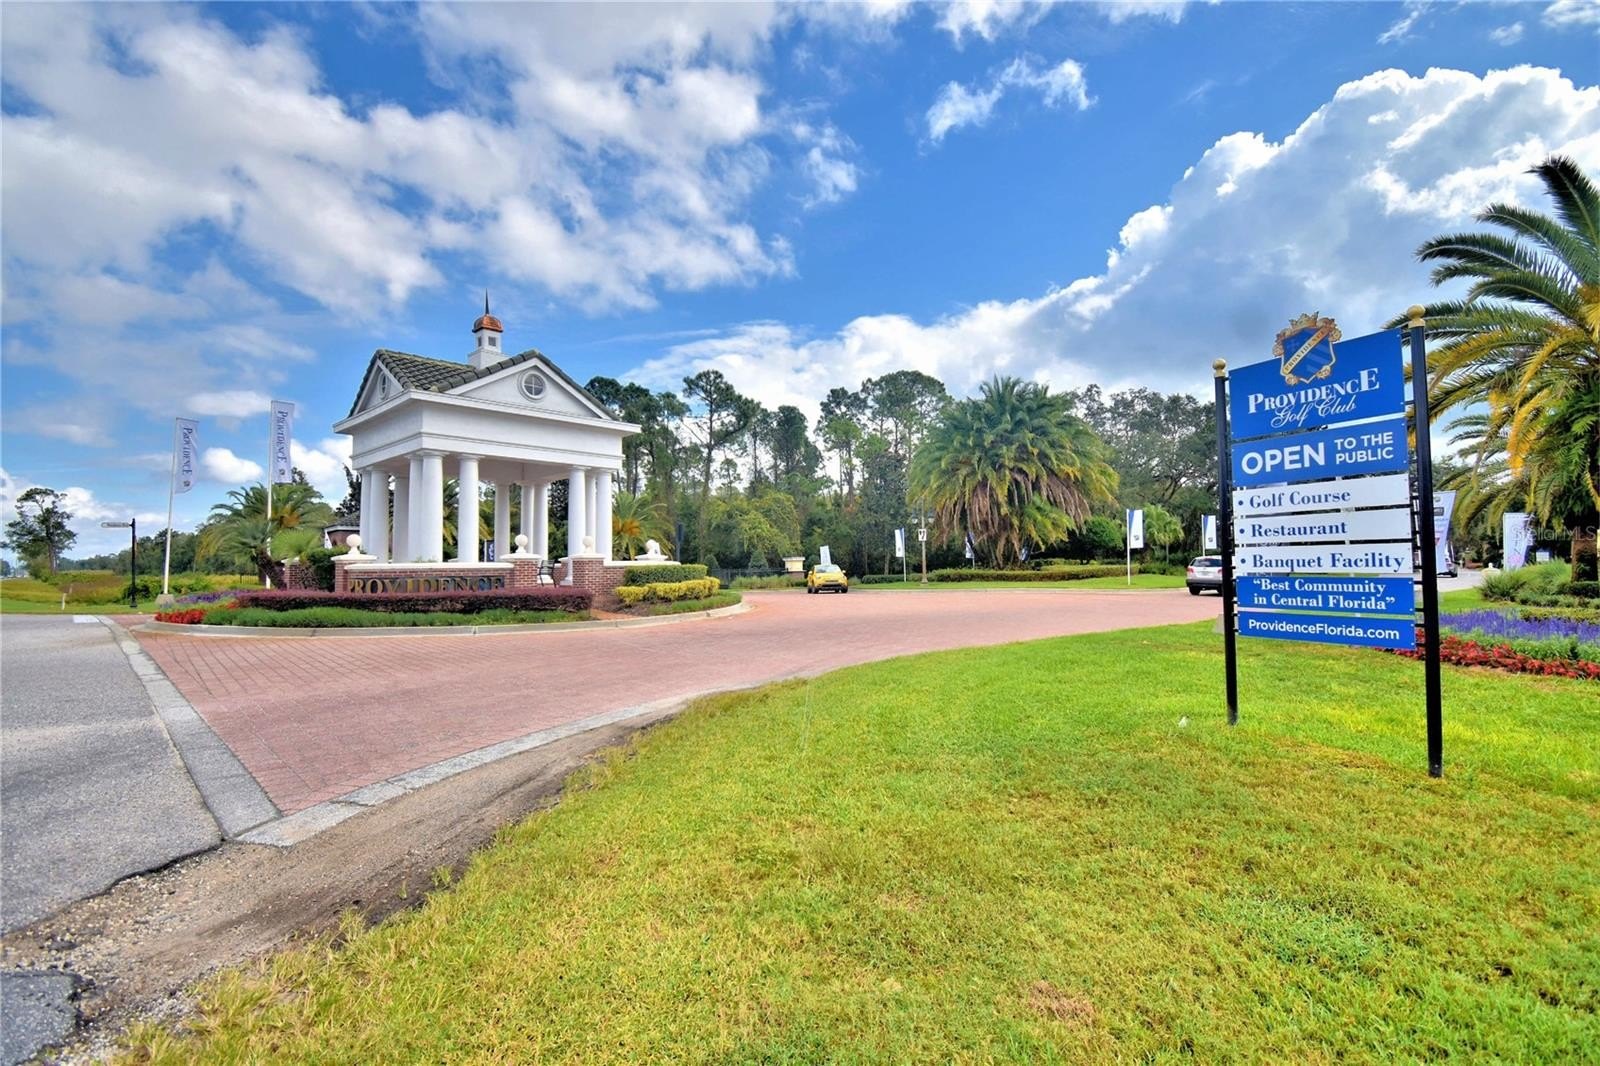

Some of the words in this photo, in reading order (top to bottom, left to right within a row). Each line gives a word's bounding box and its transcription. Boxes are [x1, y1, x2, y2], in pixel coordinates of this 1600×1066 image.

[1248, 368, 1380, 414] PROVIDENCE
[1271, 403, 1314, 428] Golf
[1314, 395, 1357, 417] Club
[1334, 437, 1357, 450] TO
[1360, 431, 1393, 447] THE
[1241, 442, 1325, 475] OPEN
[1335, 446, 1394, 465] PUBLIC
[1249, 492, 1285, 509] Golf
[1289, 490, 1351, 506] Course
[1251, 521, 1348, 538] Restaurant
[1252, 553, 1323, 572] Banquet
[1330, 552, 1405, 573] Facility
[1253, 578, 1290, 591] “Best
[1295, 579, 1386, 597] Community
[1254, 593, 1267, 605] in
[1271, 593, 1323, 607] Central
[1328, 595, 1395, 611] Florida”
[1248, 618, 1400, 640] ProvidenceFlorida.com
